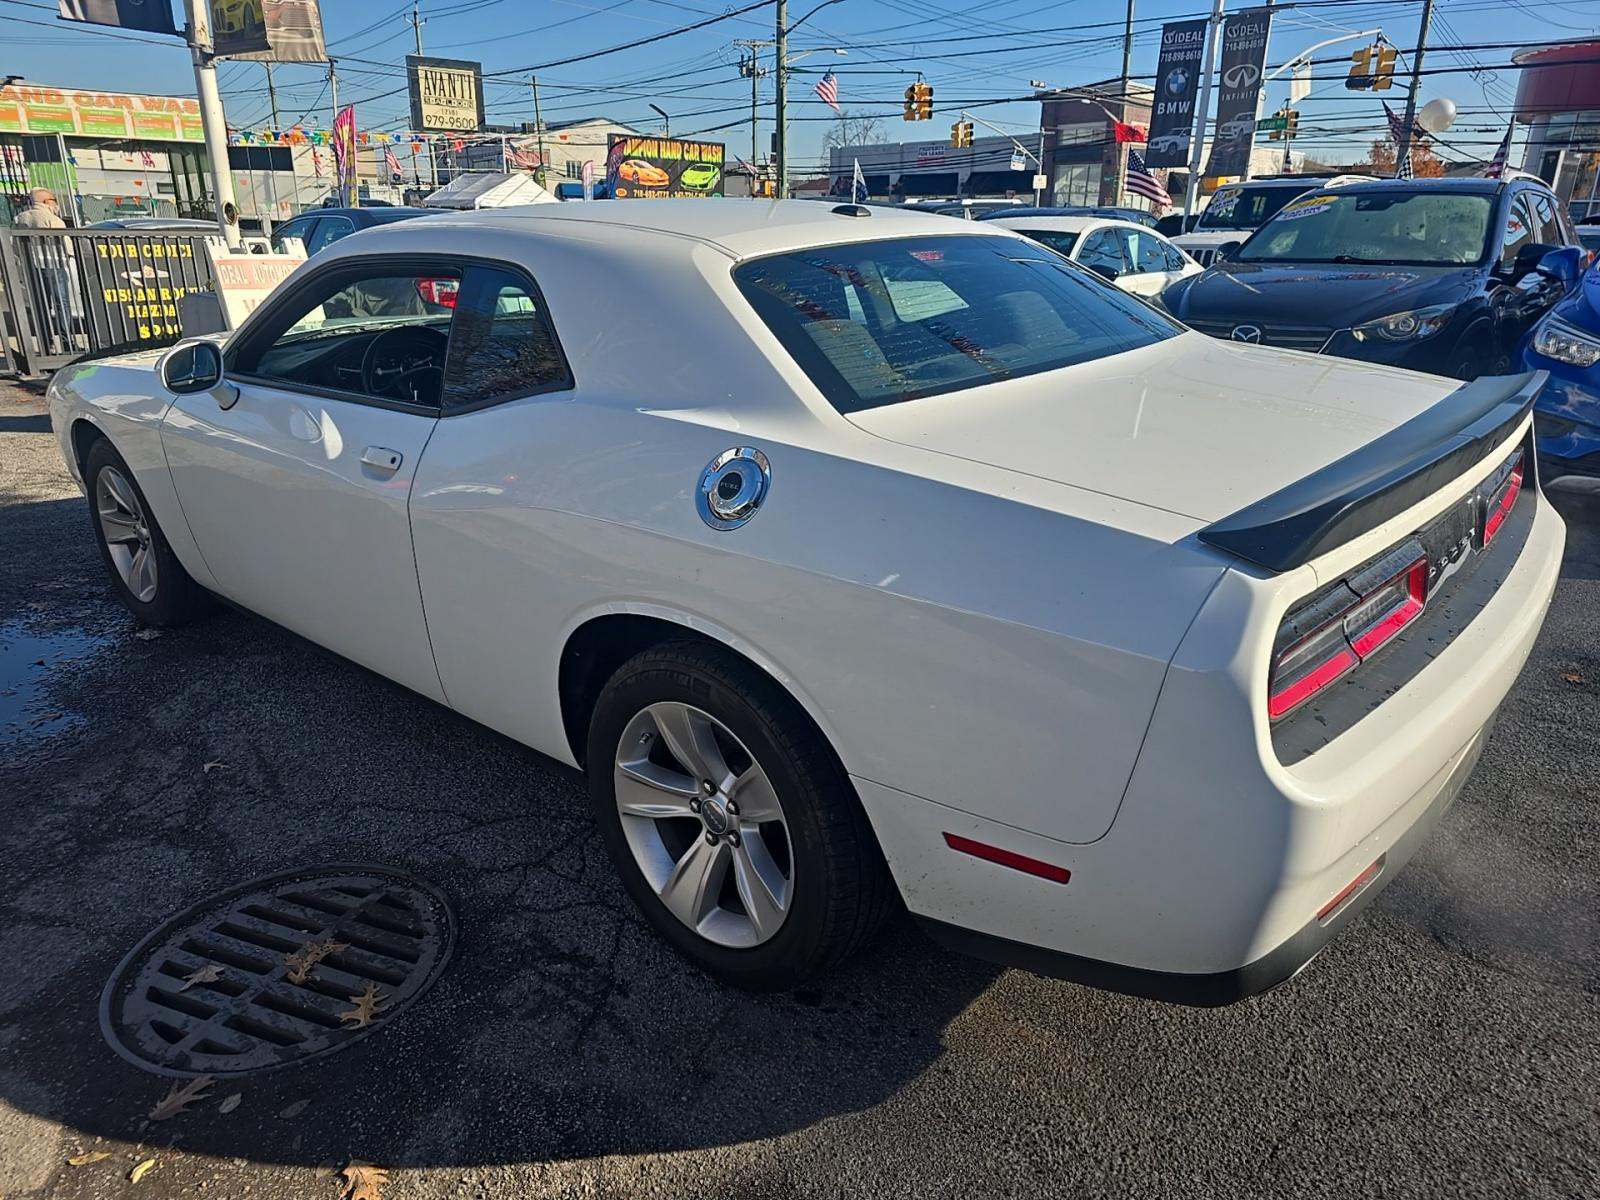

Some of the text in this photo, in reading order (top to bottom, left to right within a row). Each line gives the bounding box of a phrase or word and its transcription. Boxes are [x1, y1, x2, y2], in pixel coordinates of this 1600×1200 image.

[1174, 31, 1204, 43] IDEAL
[424, 70, 472, 99] AVANTI
[72, 92, 136, 109] CAR
[1221, 90, 1258, 101] INFINITI
[1157, 101, 1191, 115] BMW
[425, 114, 476, 129] 979-9500
[614, 136, 723, 163] AMPION HAND CAR WASH
[98, 244, 138, 258] YOUR
[127, 304, 176, 318] MAZDA
[720, 481, 739, 491] FUEL
